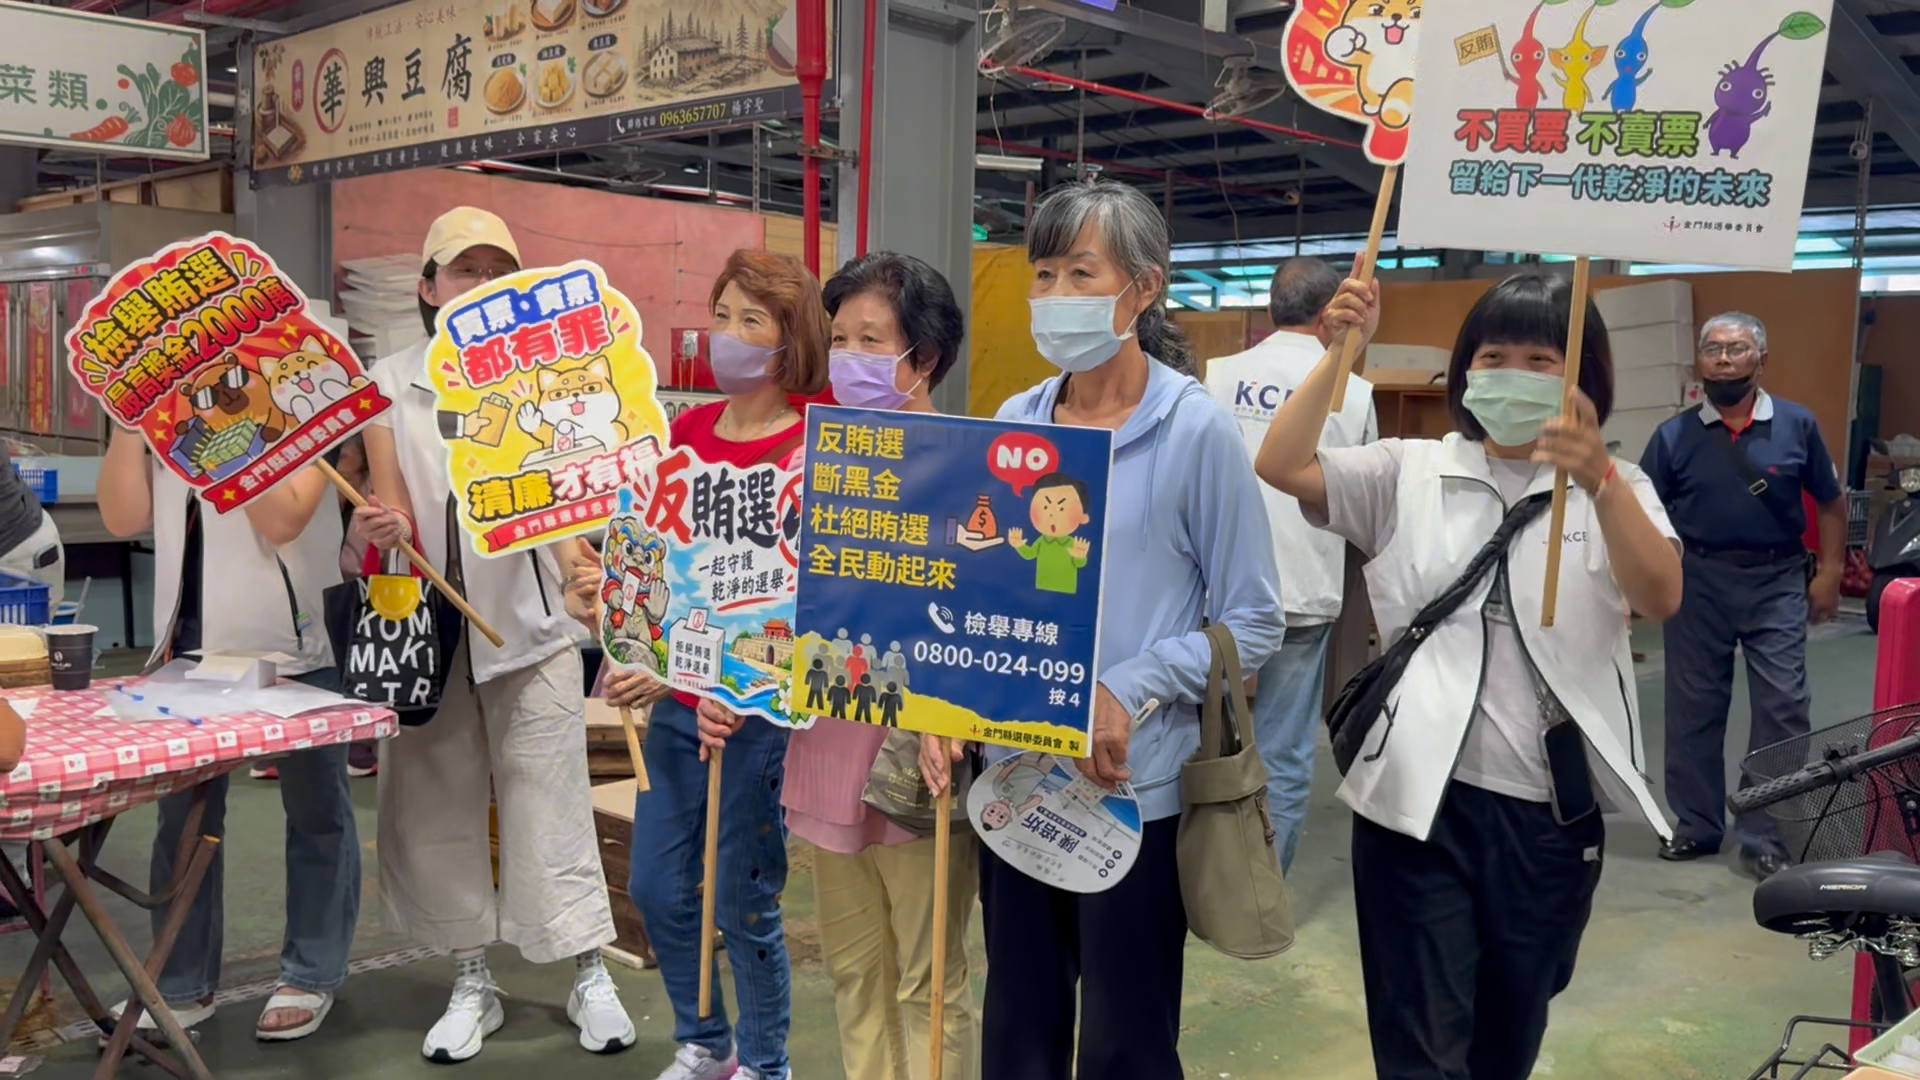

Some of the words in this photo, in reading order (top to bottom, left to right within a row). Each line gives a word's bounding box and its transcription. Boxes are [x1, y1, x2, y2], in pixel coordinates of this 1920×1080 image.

[1459, 32, 1494, 59] 反賄
[0, 63, 89, 111] 菜類
[320, 33, 473, 127] 華興豆腐
[660, 103, 726, 127] 0963657707
[1454, 108, 1571, 154] 不買票
[1576, 110, 1702, 158] 不賣票
[1450, 159, 1772, 208] 留給下一代乾淨的未來
[81, 246, 239, 368] 檢舉賄選
[104, 276, 300, 419] 最高獎金2000萬
[462, 305, 611, 386] 都有罪
[1235, 381, 1295, 410] KC
[815, 422, 904, 459] 反賄選
[997, 445, 1049, 471] NO
[645, 450, 779, 548] 反賄選
[812, 462, 902, 501] 斷黑金
[810, 504, 929, 545] 杜絕賄選
[699, 550, 754, 577] 一起守護
[808, 546, 956, 590] 全民動起來
[711, 568, 785, 602] 乾淨的選舉
[964, 611, 1059, 646] 檢舉專線
[914, 641, 1086, 685] 0800-024-099
